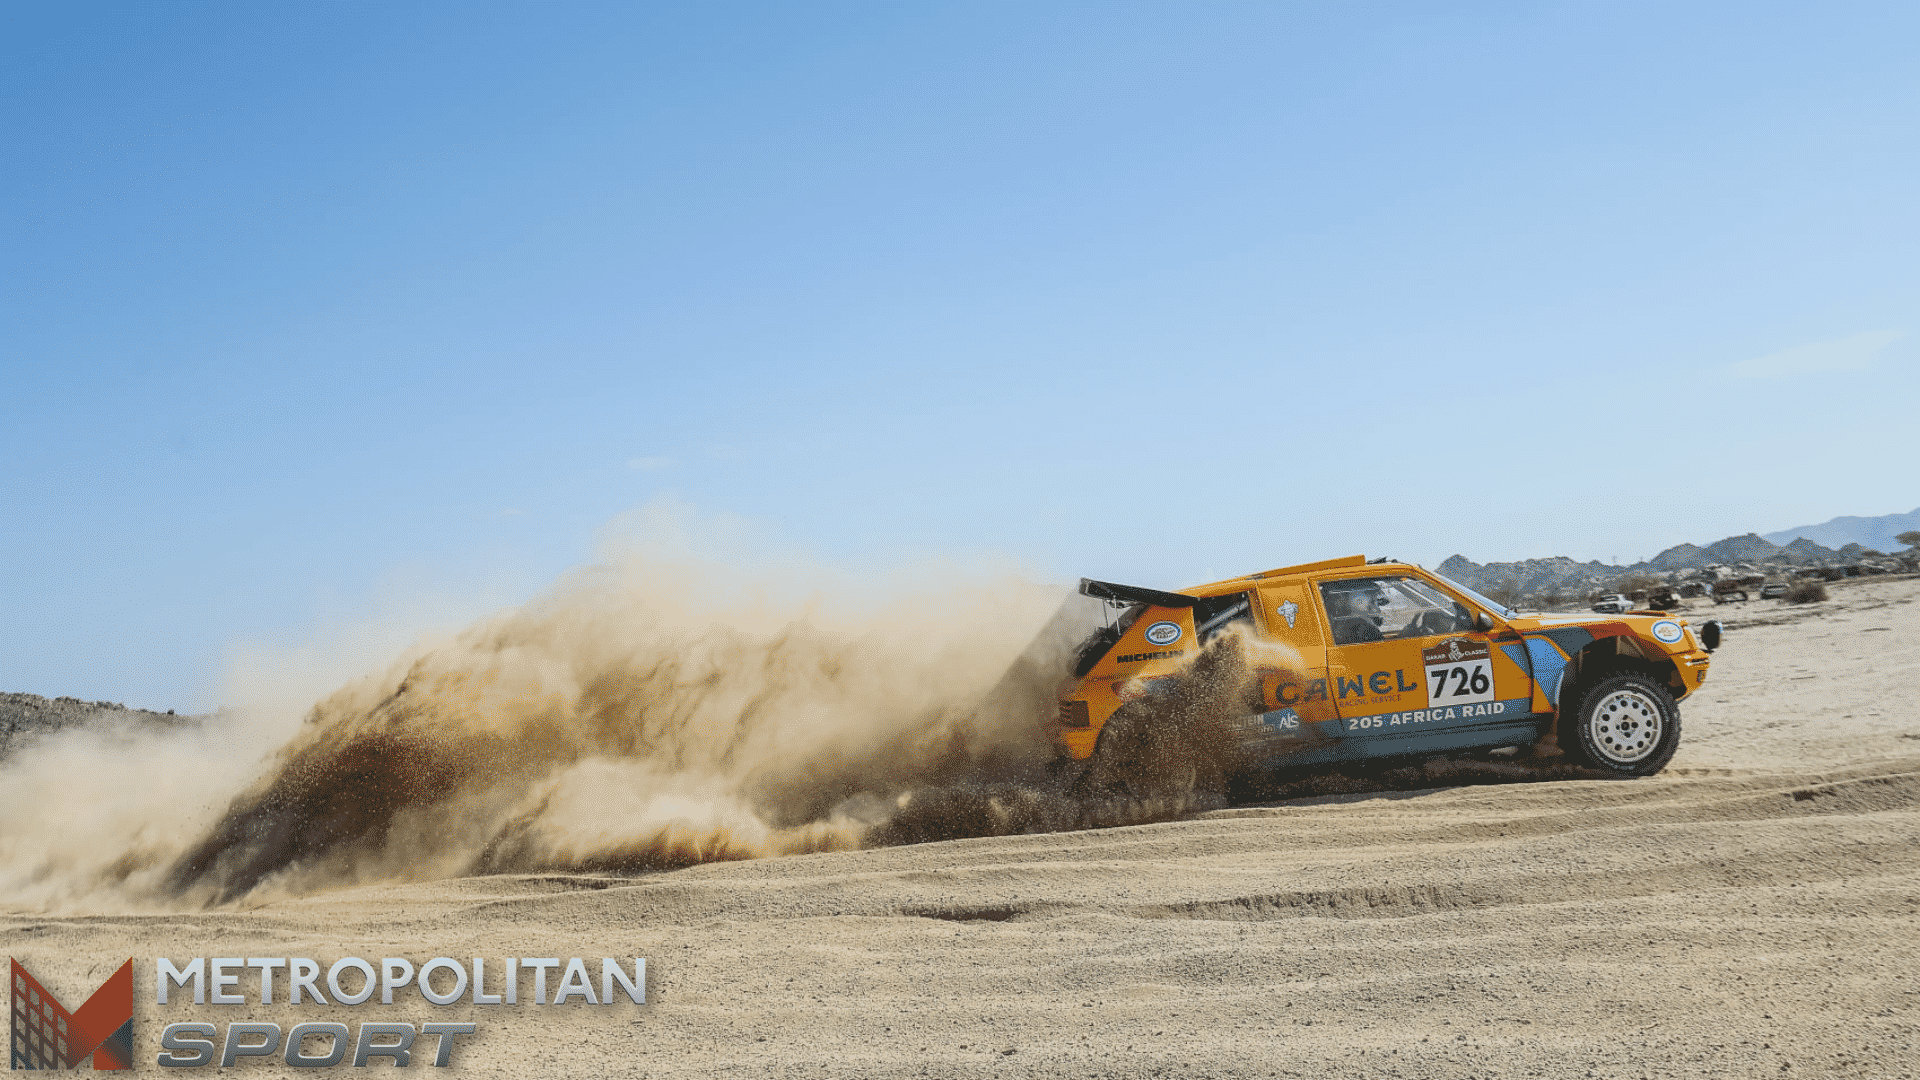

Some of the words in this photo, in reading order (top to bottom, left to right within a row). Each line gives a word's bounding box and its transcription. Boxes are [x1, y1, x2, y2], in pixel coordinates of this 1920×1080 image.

[1464, 648, 1488, 656] CLASSIC
[1430, 665, 1490, 699] 726
[1338, 697, 1369, 708] RACING
[1371, 694, 1402, 704] SERVICE
[1349, 715, 1383, 731] 205
[1390, 707, 1456, 726] AFRICA
[1462, 702, 1505, 717] RAID
